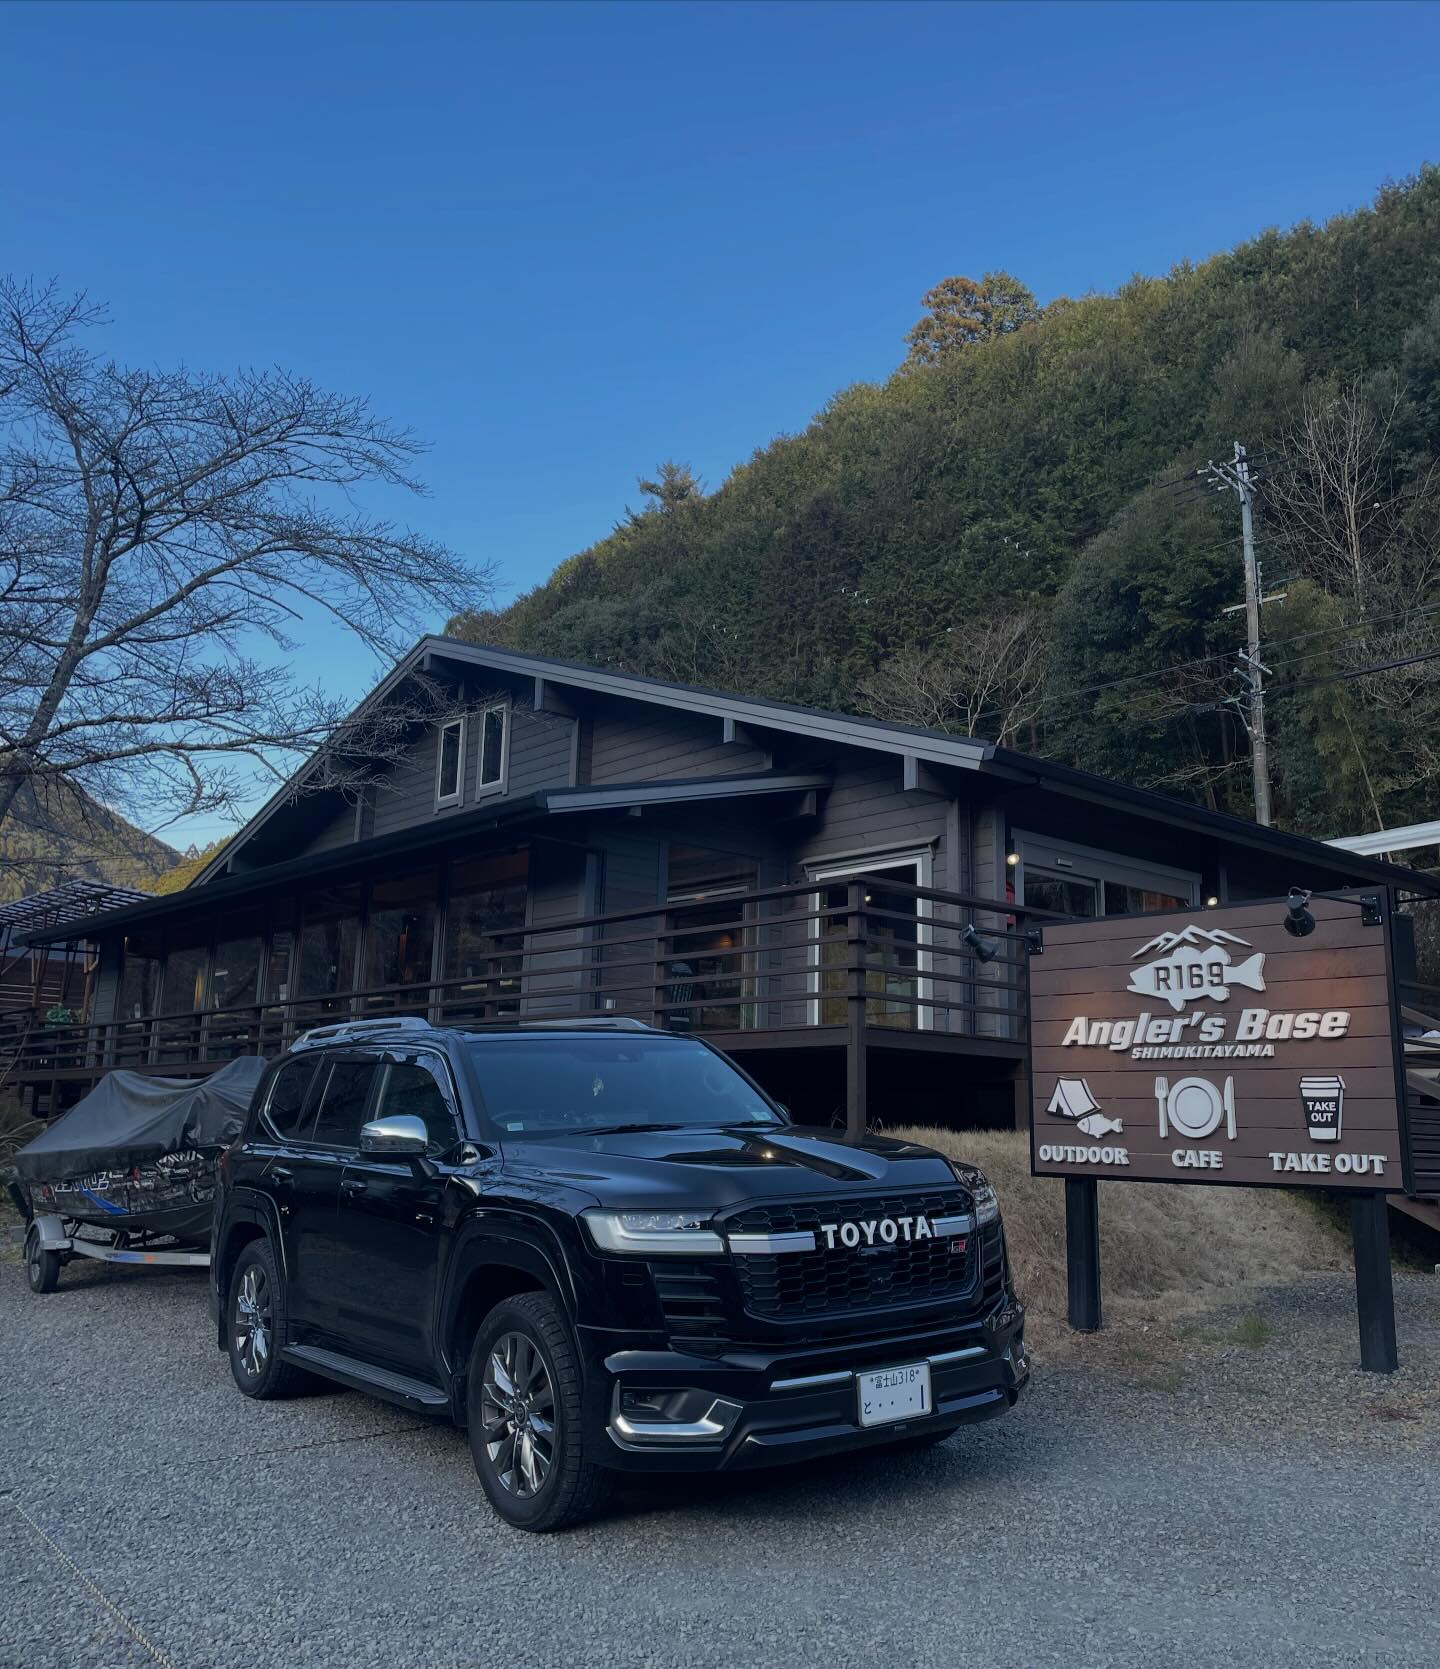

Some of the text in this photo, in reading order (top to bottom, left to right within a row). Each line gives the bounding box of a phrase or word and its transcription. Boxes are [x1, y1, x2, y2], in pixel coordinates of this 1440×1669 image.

[1153, 961, 1224, 991] R169
[1061, 1008, 1351, 1051] Angler's Base
[1131, 1044, 1275, 1060] SHIMOKITAYAMA
[1307, 1101, 1336, 1112] TAKE
[1311, 1112, 1333, 1123] OUT
[1039, 1144, 1129, 1165] OUTDOOR
[1171, 1149, 1223, 1169] CAFE
[1268, 1153, 1387, 1175] TAKE OUT
[821, 1216, 933, 1249] TOYOTA
